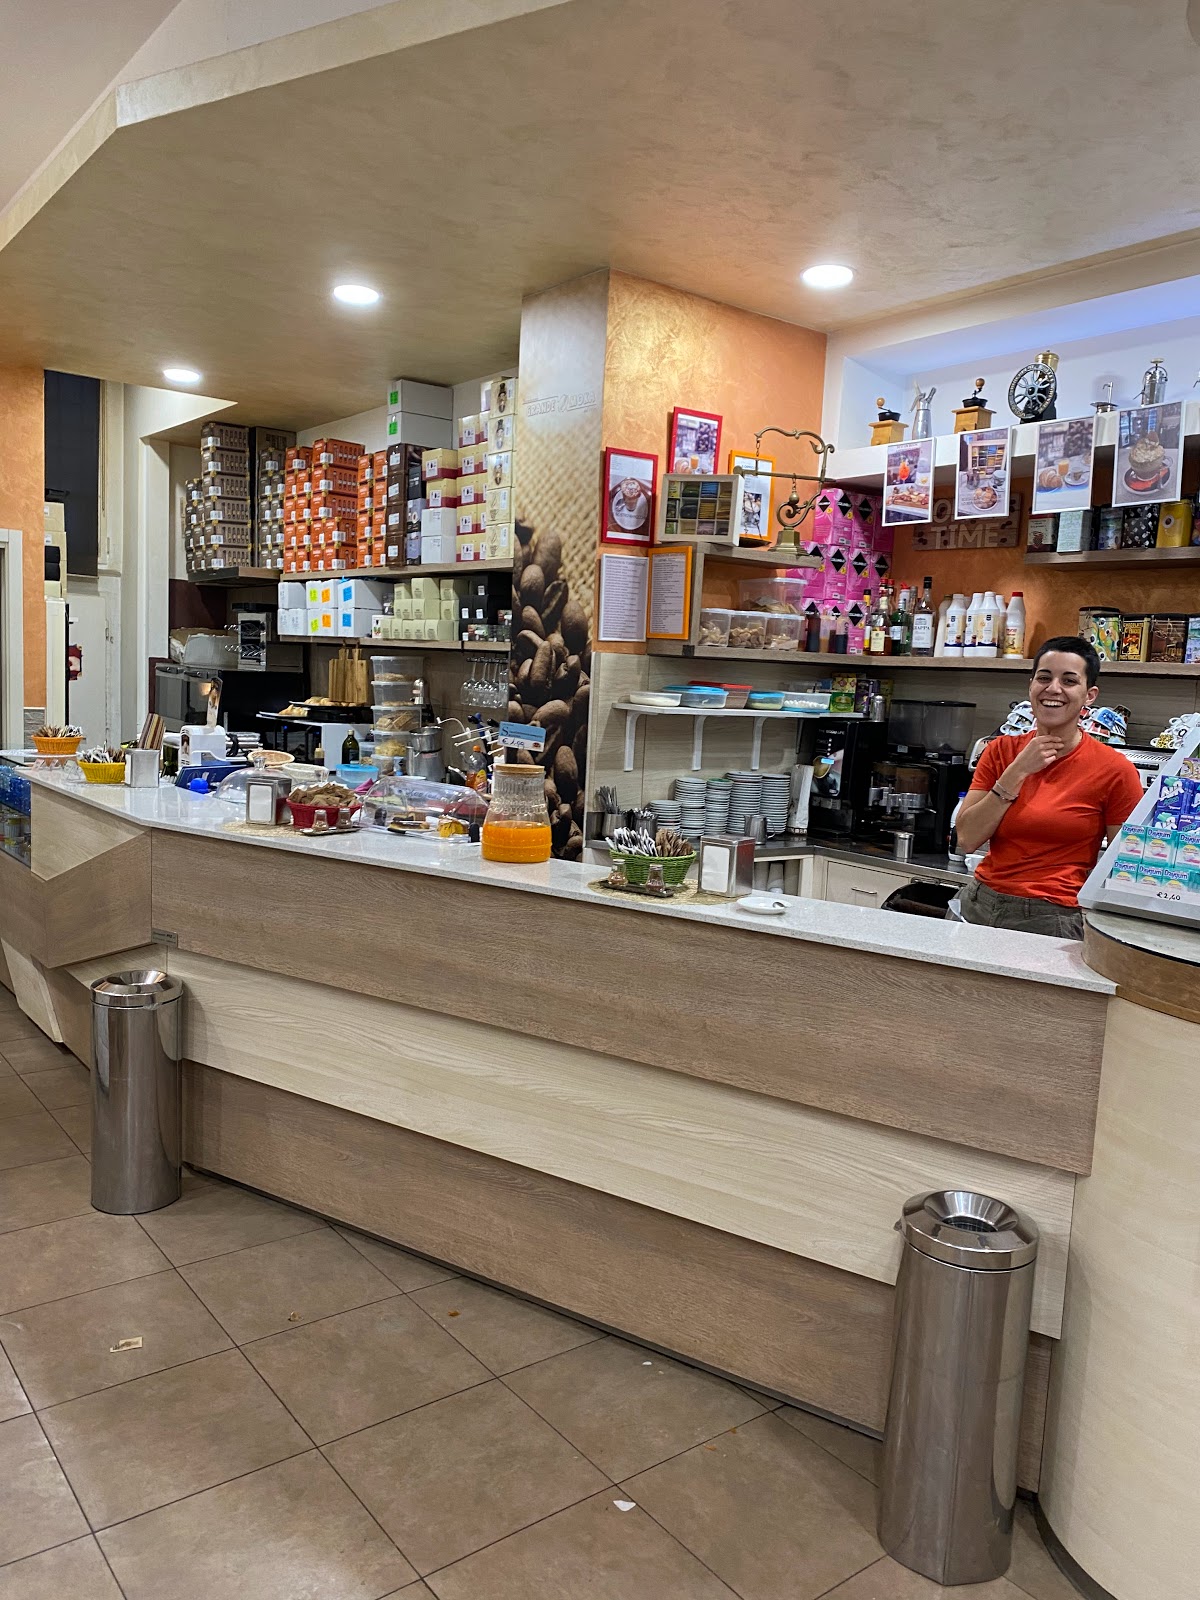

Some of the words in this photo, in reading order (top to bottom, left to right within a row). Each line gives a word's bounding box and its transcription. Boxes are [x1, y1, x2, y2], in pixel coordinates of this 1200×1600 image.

[930, 522, 999, 549] TIME
[1122, 824, 1145, 834] Daygum
[1147, 829, 1171, 839] Daygum
[1114, 861, 1136, 871] Daygum
[1139, 865, 1162, 876] Daygum
[1164, 869, 1188, 880] Daygum
